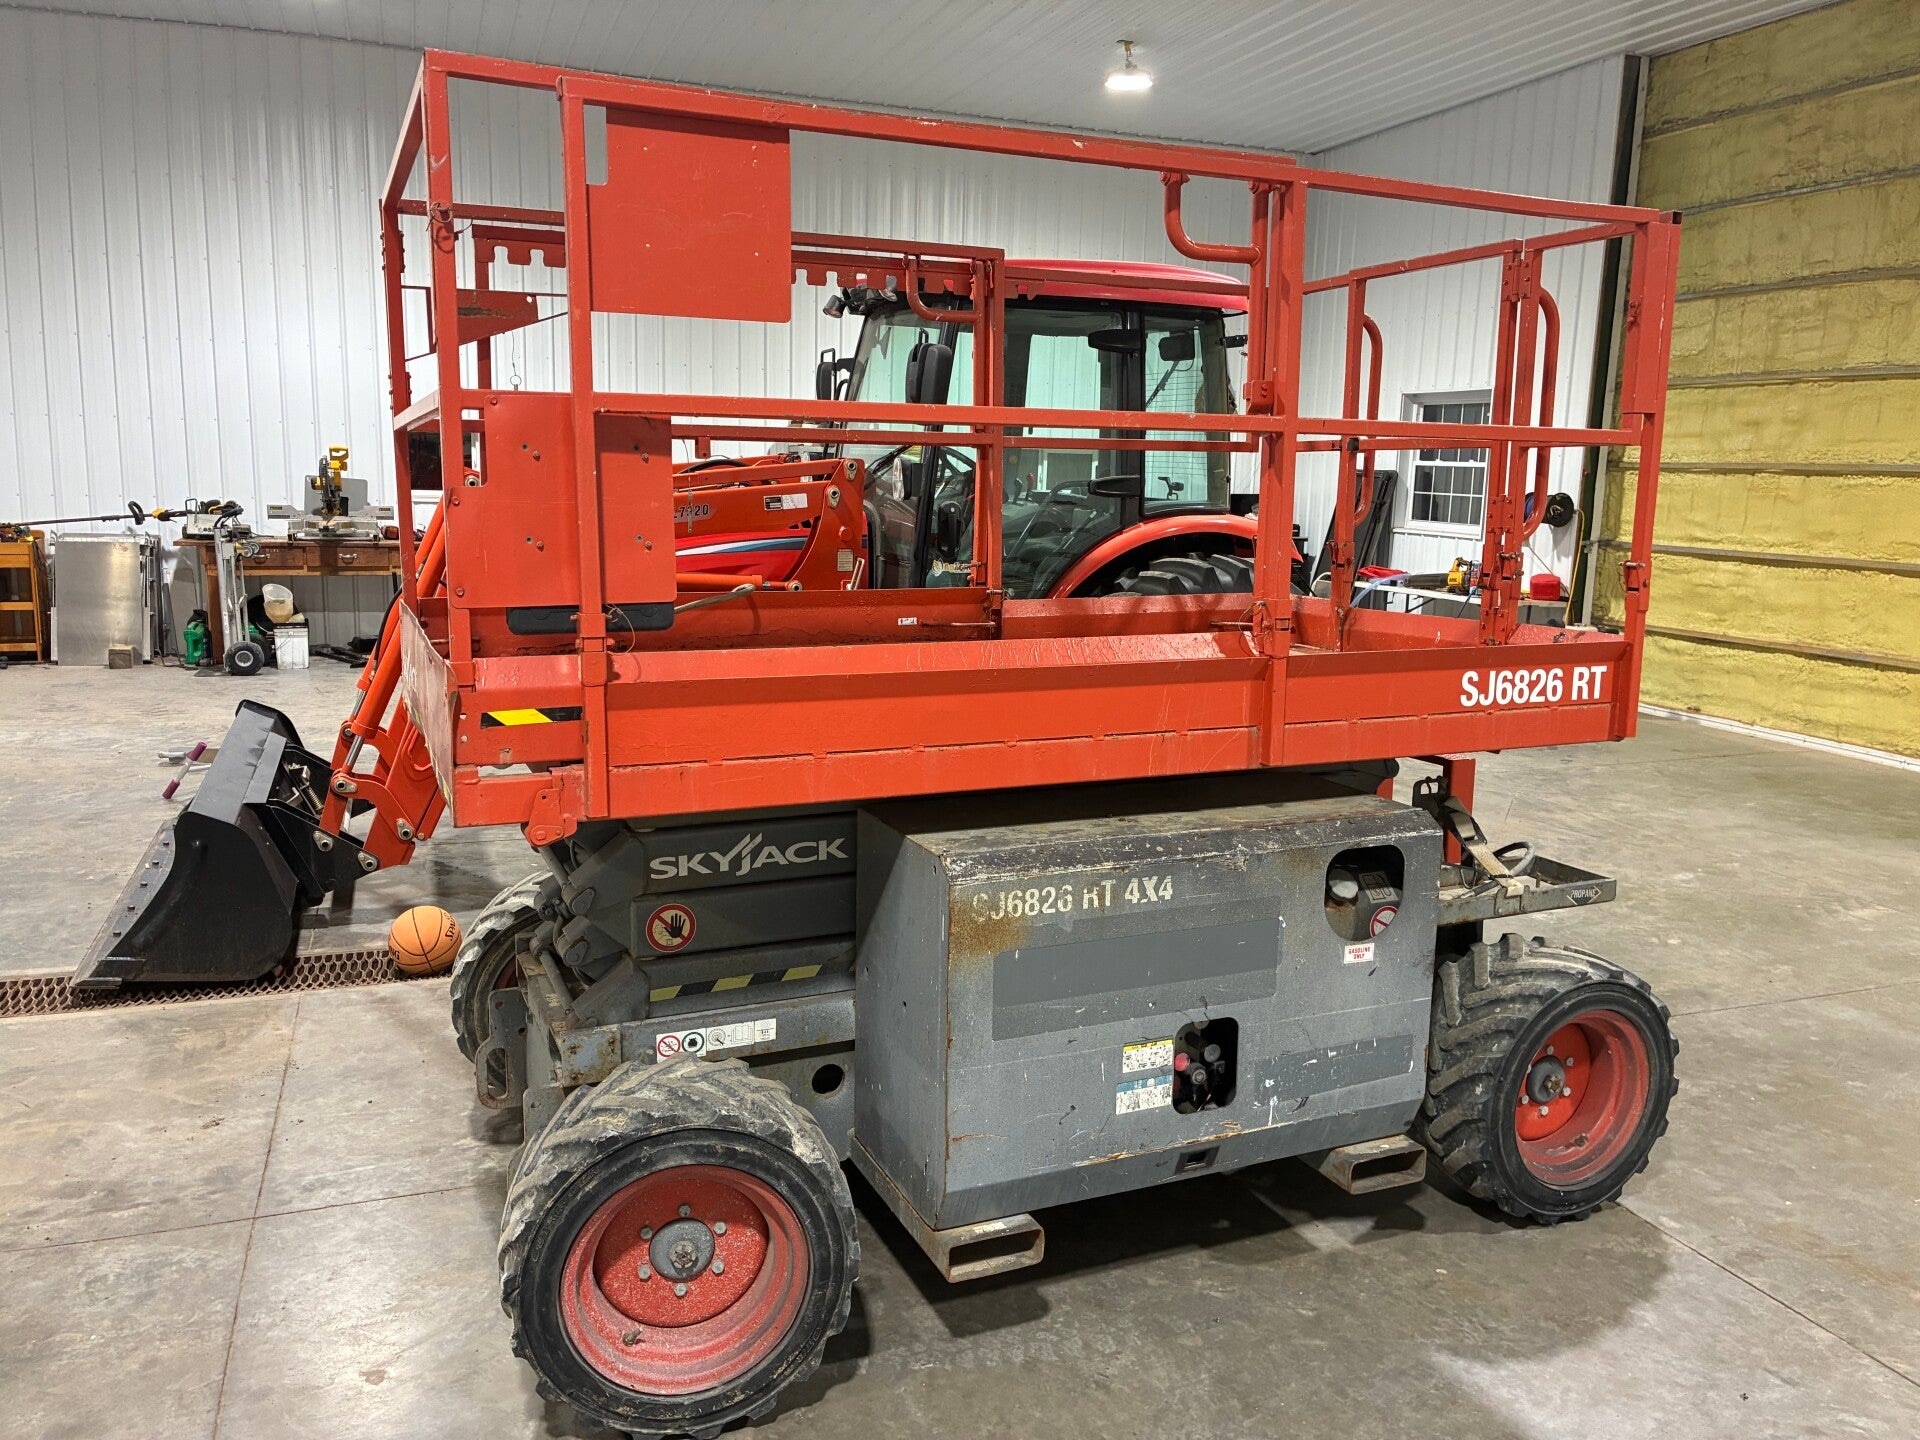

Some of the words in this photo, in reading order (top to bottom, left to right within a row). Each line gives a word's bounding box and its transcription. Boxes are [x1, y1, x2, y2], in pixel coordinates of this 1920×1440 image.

[1460, 667, 1564, 707] SJ6826
[1571, 665, 1608, 701] RT
[649, 832, 849, 880] SKYJACK
[971, 884, 1074, 922] SJ6826
[1570, 889, 1596, 899] PROPANE
[1348, 946, 1371, 954] GASOLINE
